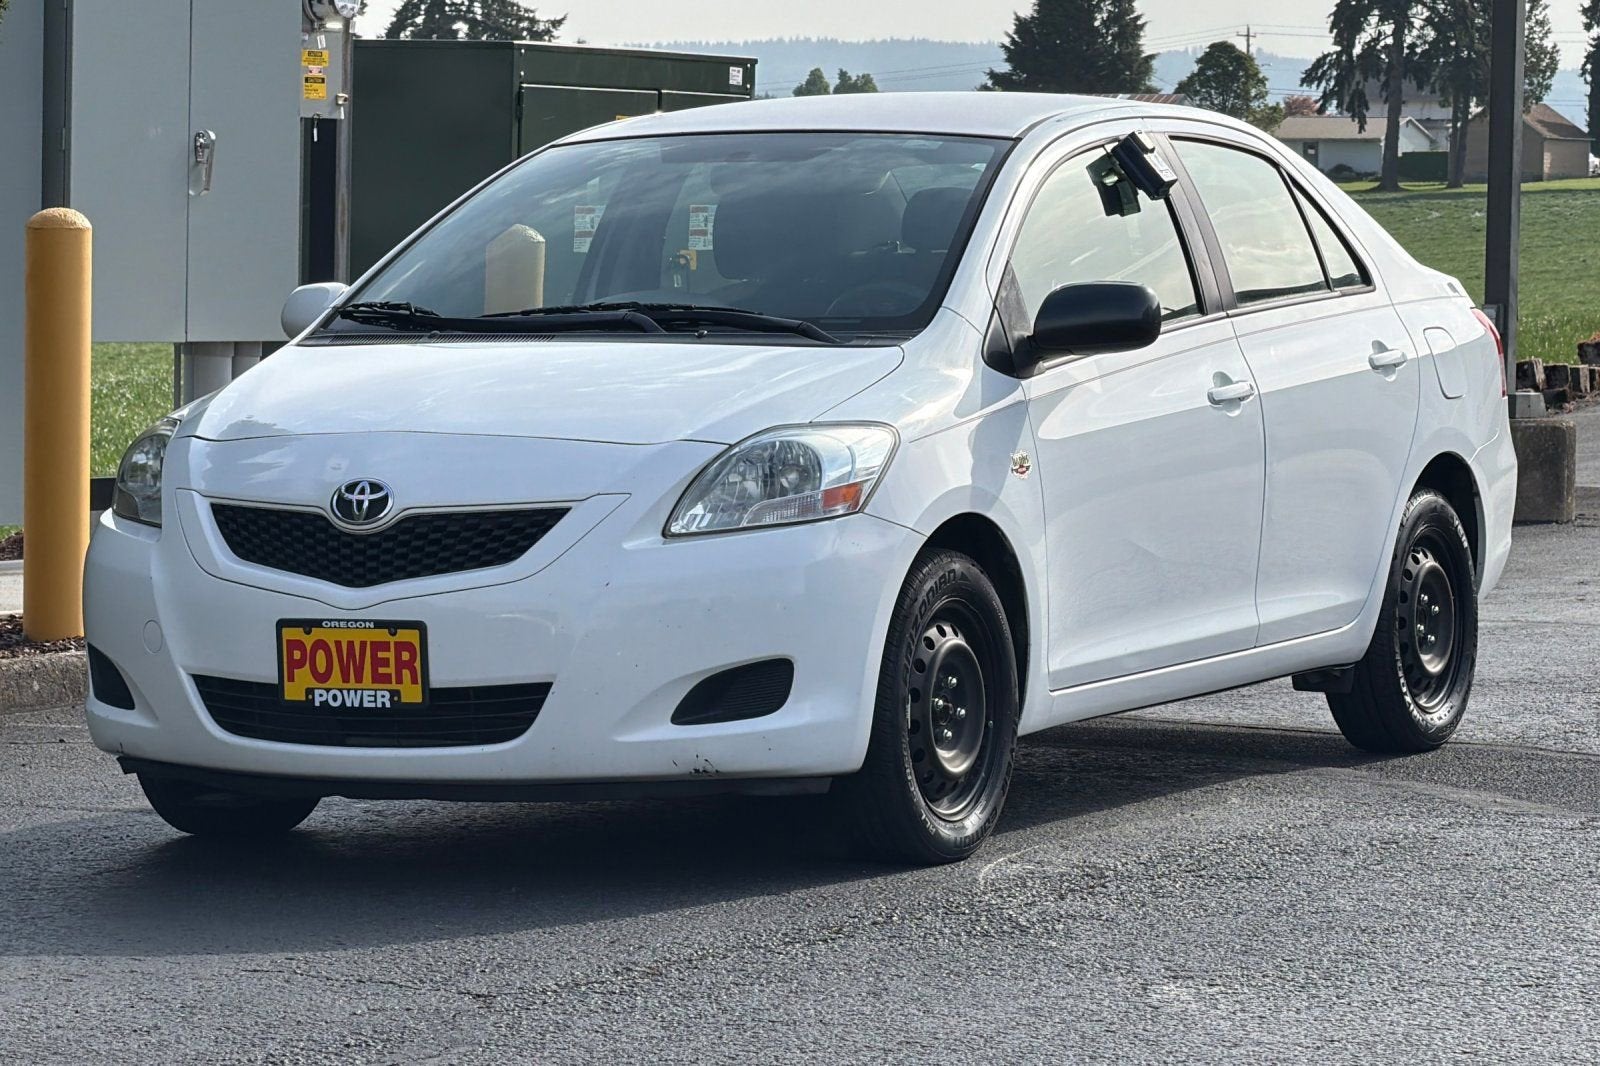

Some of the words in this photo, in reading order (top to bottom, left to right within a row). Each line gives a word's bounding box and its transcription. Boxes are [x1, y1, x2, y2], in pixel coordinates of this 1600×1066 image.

[321, 620, 375, 629] OREGON
[285, 638, 419, 685] POWER
[314, 688, 391, 708] POWER
